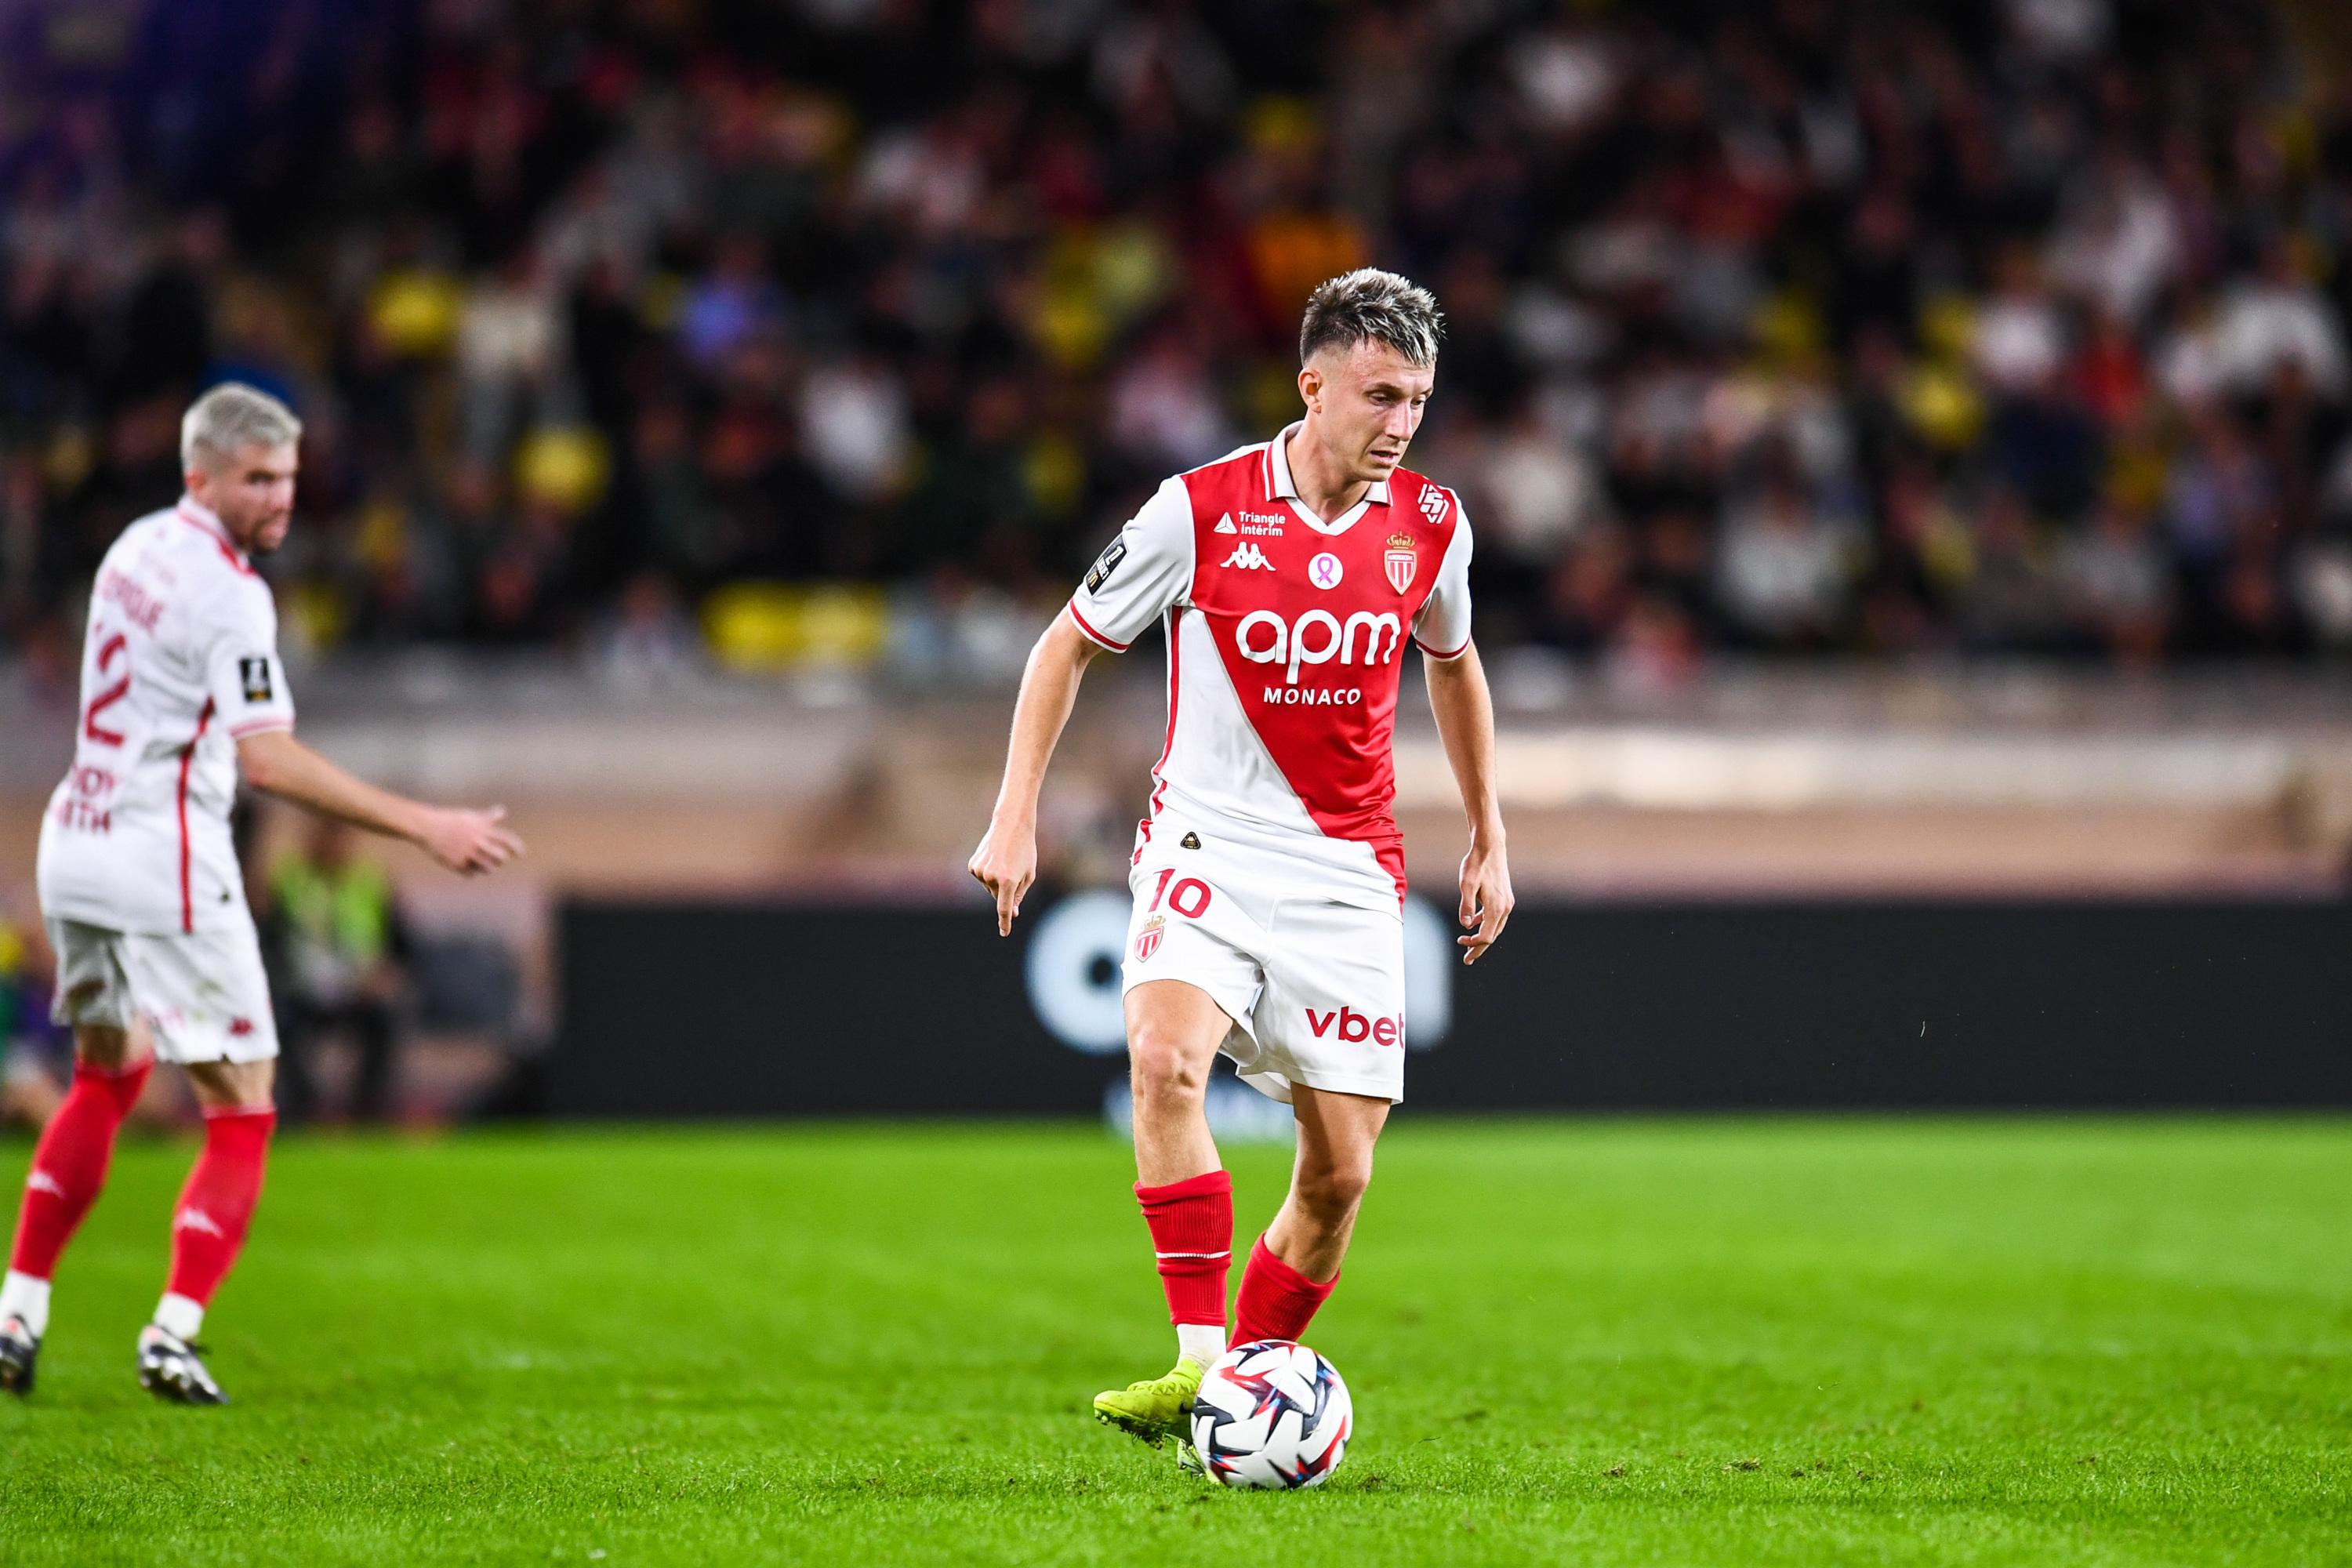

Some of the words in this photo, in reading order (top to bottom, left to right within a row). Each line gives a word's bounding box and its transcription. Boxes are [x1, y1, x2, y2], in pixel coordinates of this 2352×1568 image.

[1239, 511, 1286, 526] Triangle
[1241, 524, 1283, 536] intérim
[1236, 609, 1401, 684] apm
[1263, 687, 1361, 705] MONACO
[1148, 868, 1212, 919] 10
